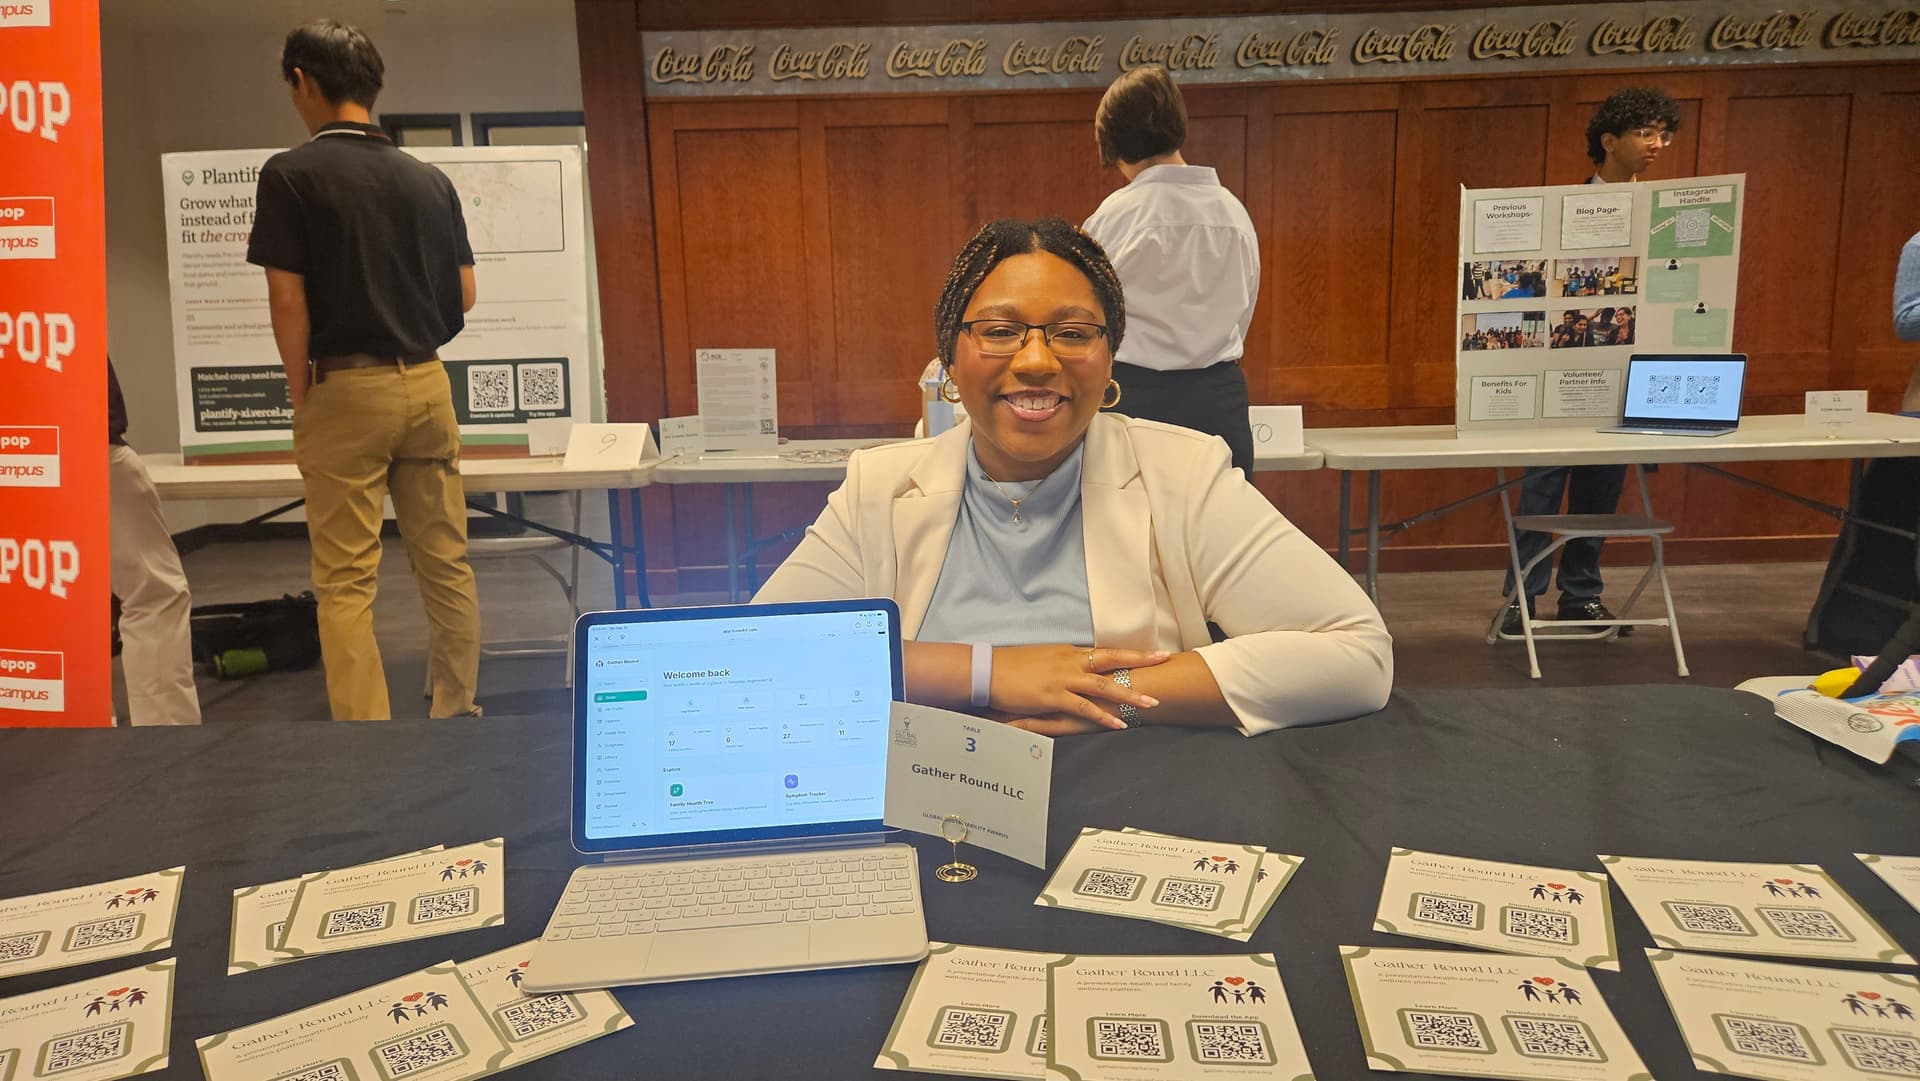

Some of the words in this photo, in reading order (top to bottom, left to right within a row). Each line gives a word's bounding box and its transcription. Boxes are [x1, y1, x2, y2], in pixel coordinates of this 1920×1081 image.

[1673, 188, 1718, 198] Instagram
[180, 197, 216, 210] Grow
[219, 194, 253, 209] what
[1679, 196, 1711, 205] Handle
[1576, 207, 1595, 215] Blog
[181, 212, 231, 227] instead
[233, 211, 246, 225] of
[182, 229, 196, 244] fit
[200, 230, 222, 244] the
[1482, 380, 1513, 388] Benefits
[1514, 380, 1527, 388] For
[1560, 378, 1588, 386] Partner
[1495, 387, 1512, 395] Kids
[0, 537, 80, 599] POP
[663, 670, 706, 680] Welcome
[707, 668, 731, 678] back
[963, 725, 982, 734] TABLE
[964, 736, 977, 753] 3
[912, 763, 956, 781] Gather
[959, 773, 998, 793] Round
[1003, 785, 1025, 801] LLC
[950, 957, 1000, 969] Gather
[1374, 961, 1428, 970] Gather
[1432, 963, 1483, 974] Round
[1487, 966, 1521, 976] LLC
[1076, 969, 1127, 977] Gather
[1133, 968, 1179, 977] Round
[1184, 968, 1216, 977] LLC
[231, 1027, 294, 1050] Gather
[299, 1007, 354, 1031] Round
[357, 994, 392, 1012] LLC
